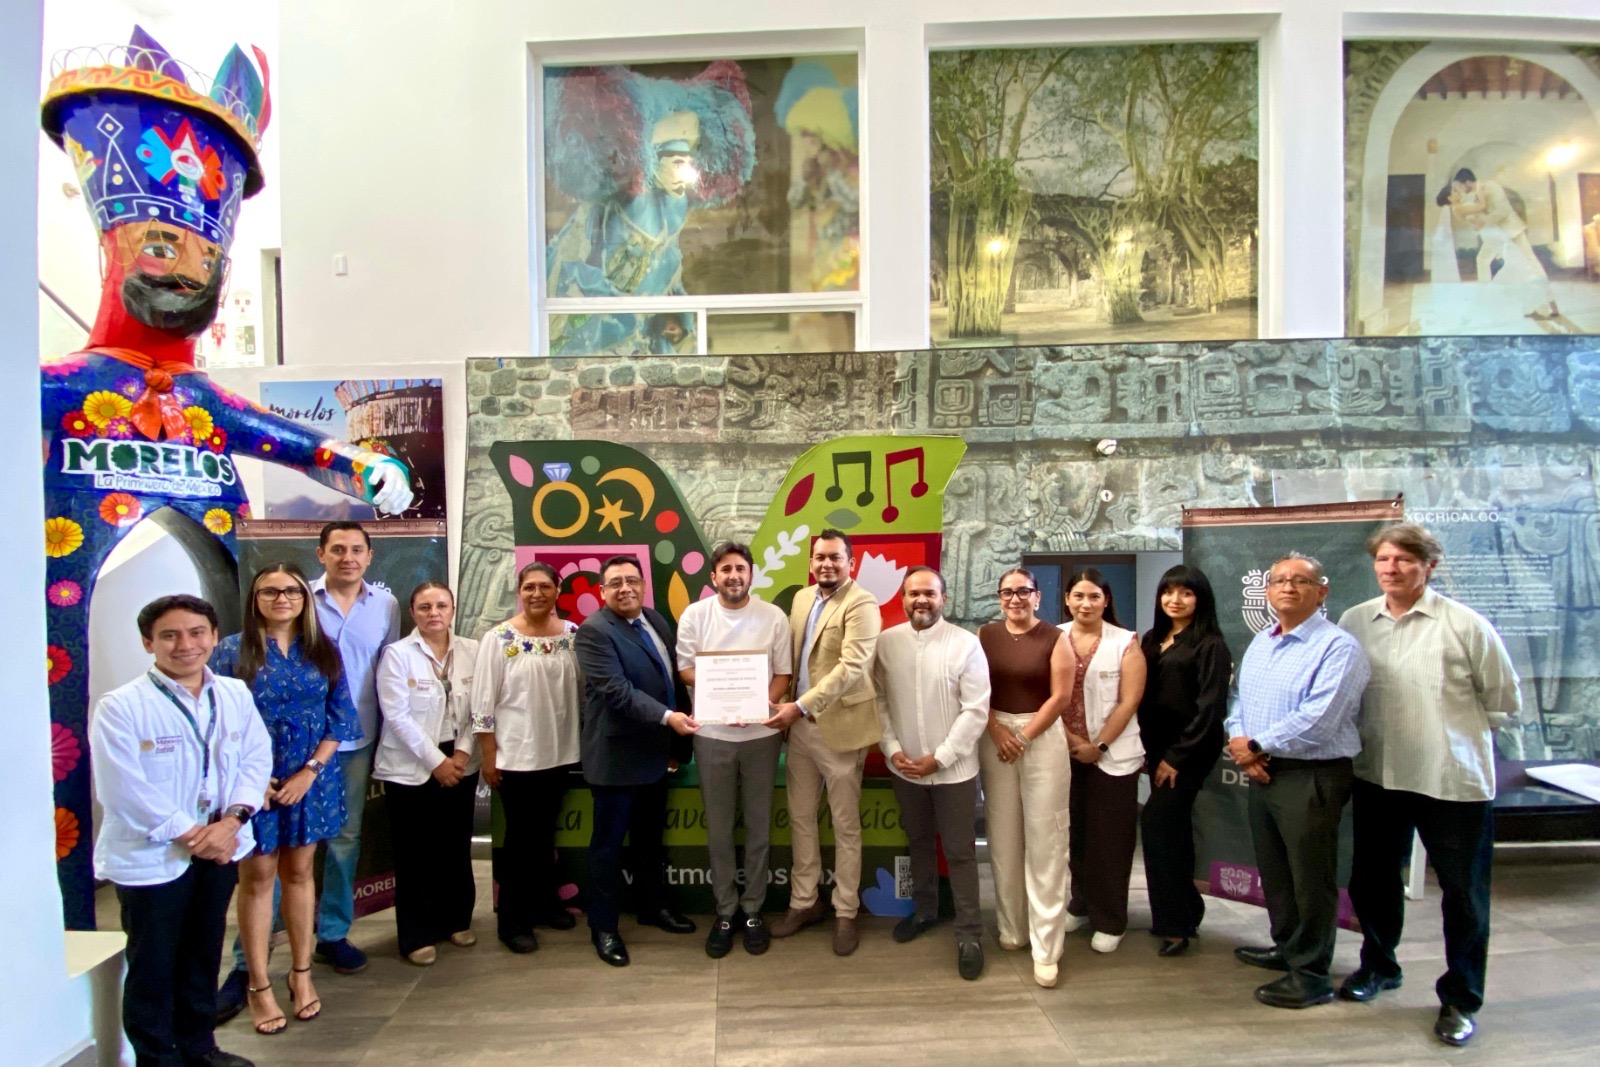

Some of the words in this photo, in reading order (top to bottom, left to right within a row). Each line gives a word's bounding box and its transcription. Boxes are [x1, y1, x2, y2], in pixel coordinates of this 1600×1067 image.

[65, 440, 235, 483] MORELOS
[97, 475, 113, 487] La
[1406, 511, 1499, 523] XOCHICALCO
